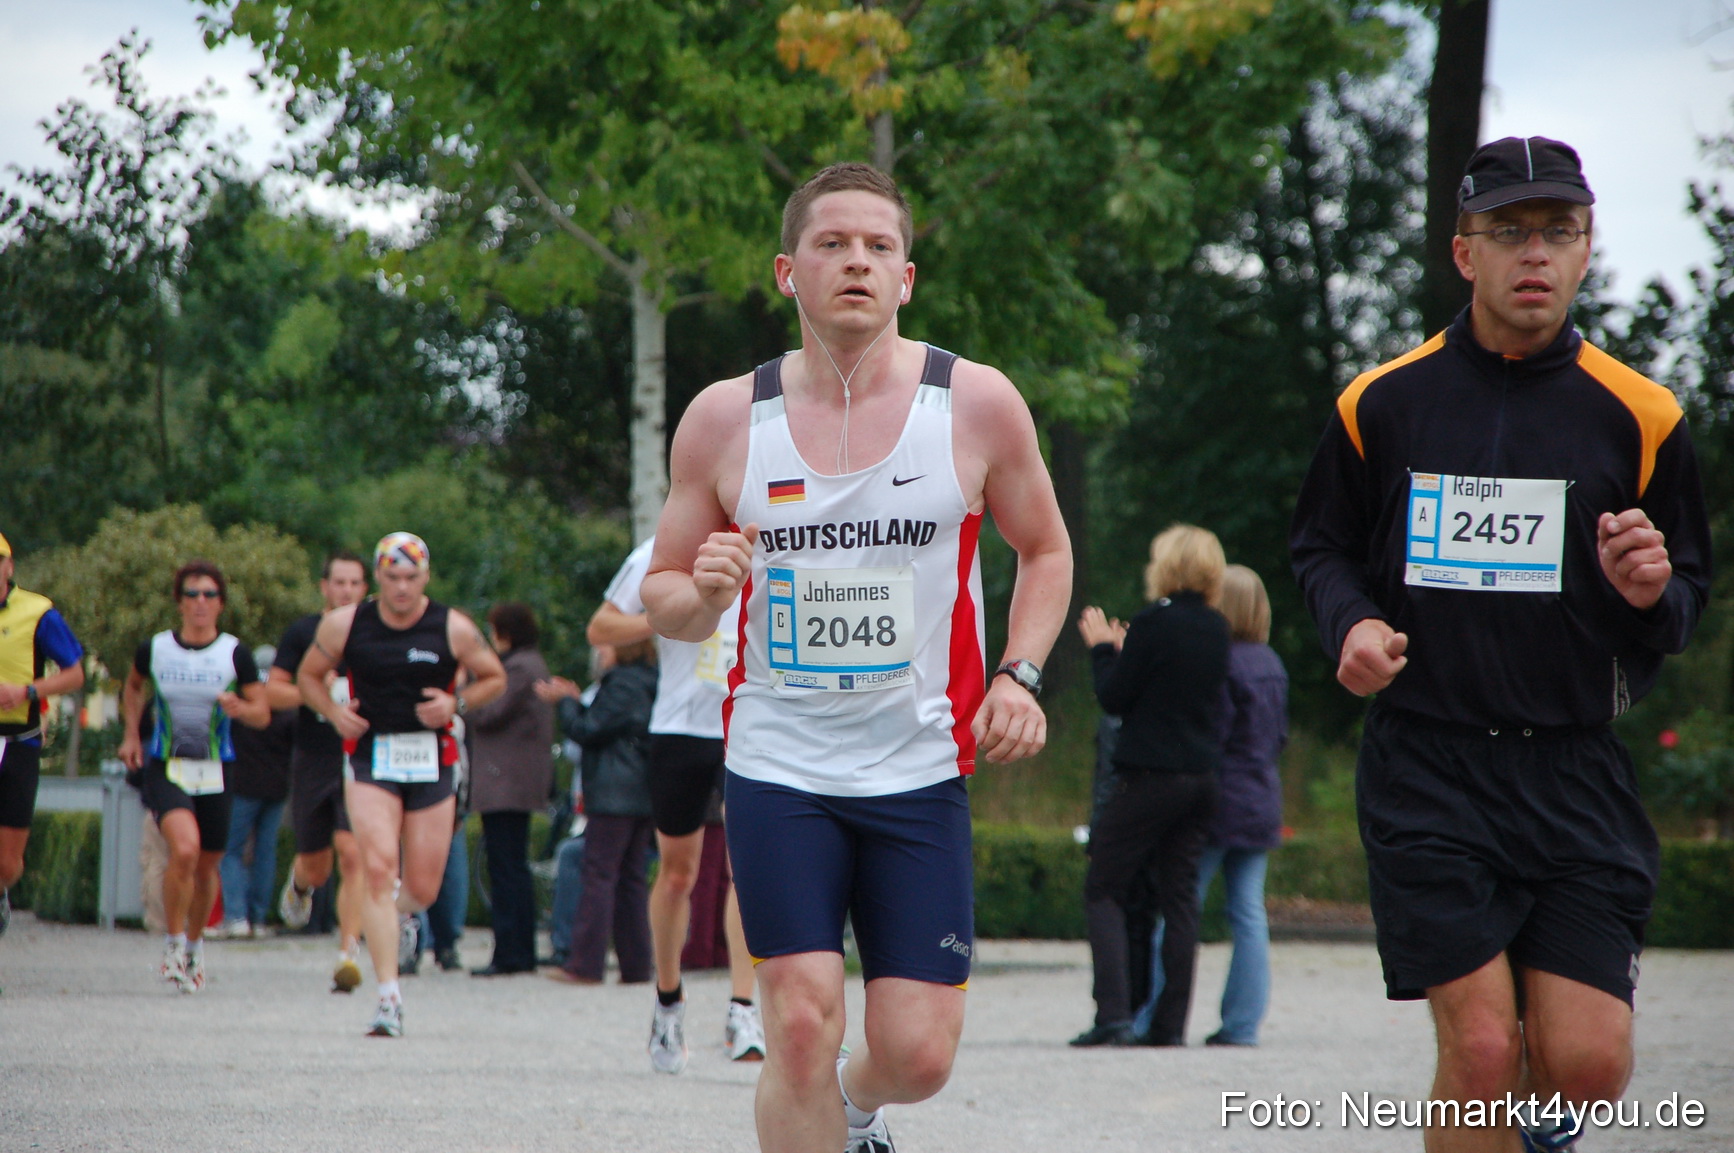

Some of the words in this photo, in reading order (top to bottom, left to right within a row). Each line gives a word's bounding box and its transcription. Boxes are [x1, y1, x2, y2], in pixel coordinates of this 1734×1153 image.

[1453, 476, 1502, 502] Ralph
[1418, 506, 1427, 522] A
[759, 518, 937, 553] DEUTSCHLAND
[1451, 511, 1544, 545] 2457
[1498, 571, 1557, 582] PFLEIDERER
[803, 581, 890, 602] Johannes
[777, 612, 785, 628] C
[807, 615, 897, 647] 2048
[855, 668, 911, 684] PFLEIDERER
